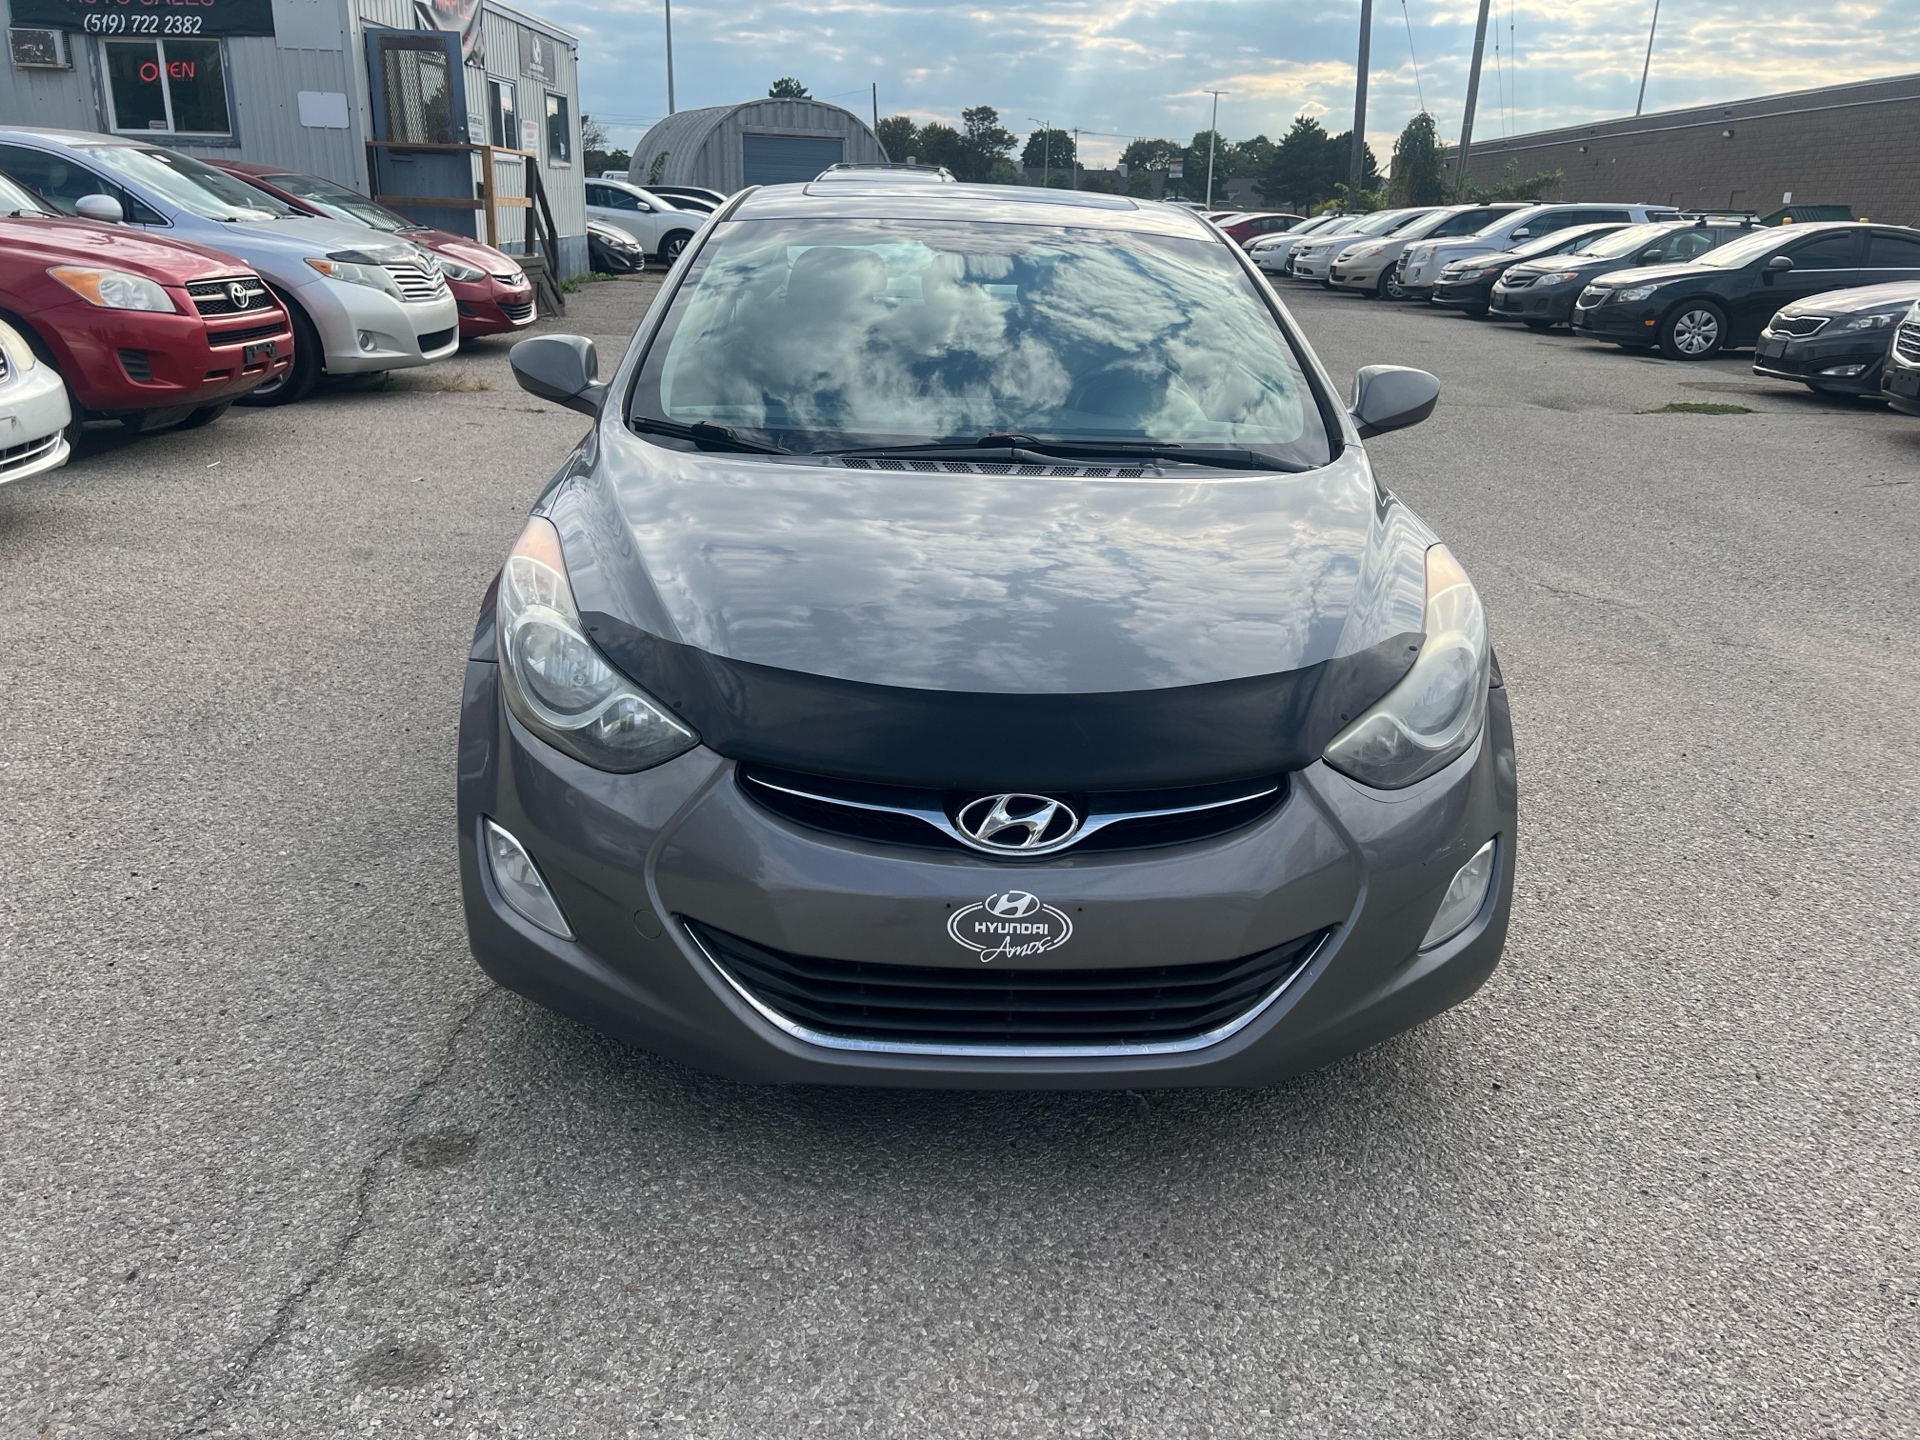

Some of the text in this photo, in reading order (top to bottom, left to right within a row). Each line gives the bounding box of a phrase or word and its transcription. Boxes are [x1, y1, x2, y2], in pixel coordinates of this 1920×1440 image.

[83, 13, 203, 34] (519) 722 2382
[974, 921, 1049, 935] HYUNDAI
[980, 935, 1053, 963] Amos
